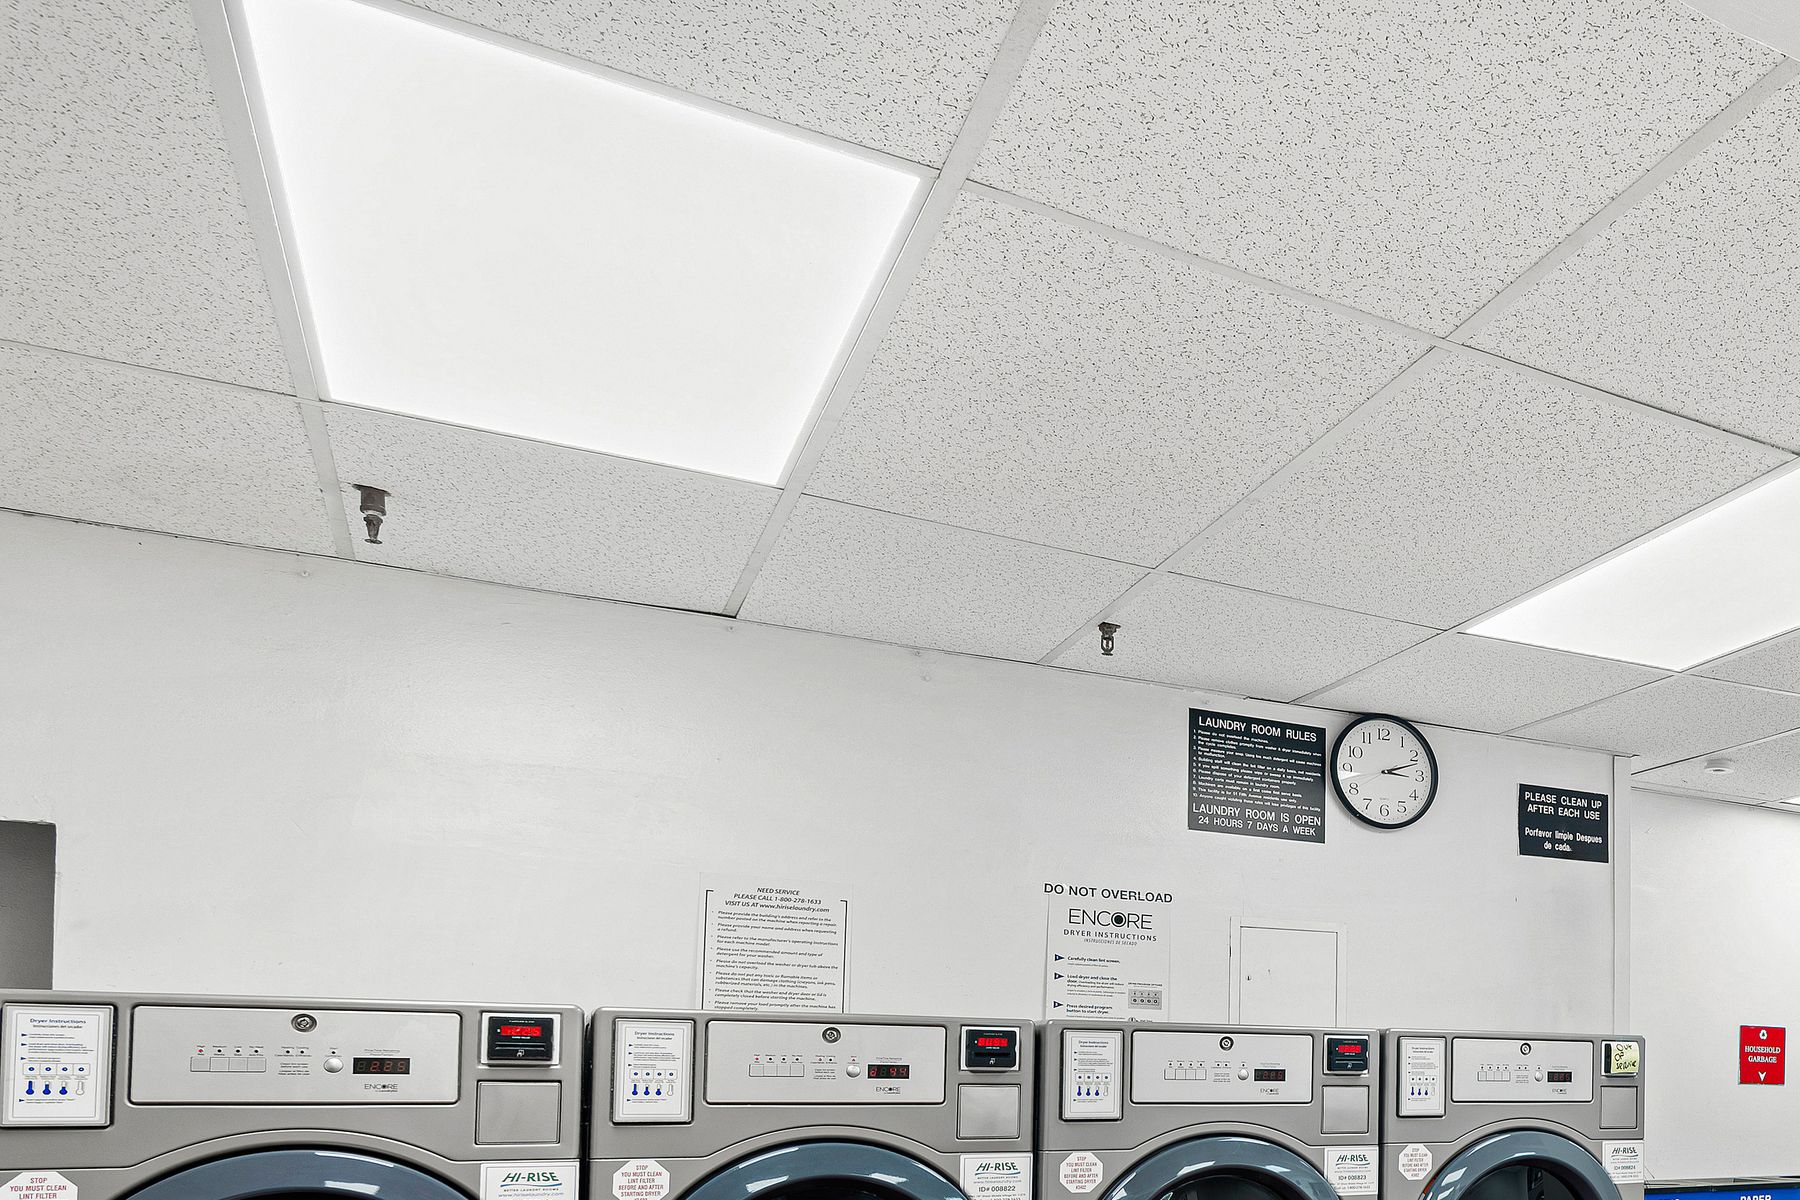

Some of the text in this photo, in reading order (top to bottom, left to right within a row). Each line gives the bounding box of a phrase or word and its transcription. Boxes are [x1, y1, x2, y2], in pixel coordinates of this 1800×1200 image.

[1198, 716, 1317, 742] LAUNDRY ROOM RULES
[1377, 728, 1390, 741] 12
[1362, 731, 1372, 744] 11
[1401, 736, 1404, 748] 1
[1348, 745, 1363, 758] 10
[1409, 750, 1419, 762] 2
[1342, 762, 1353, 773] 9
[1415, 770, 1424, 782] 3
[1348, 782, 1359, 795] 8
[1409, 789, 1419, 801] 4
[1363, 798, 1372, 810] 7
[1397, 800, 1407, 813] 5
[1525, 791, 1602, 809] PLEASE CLEAN UP
[1192, 803, 1321, 826] LAUNDRY ROOM IS OPEN
[1380, 804, 1389, 817] 6
[1527, 804, 1600, 820] AFTER EACH USE
[1198, 816, 1316, 836] 24 HOURS 7 DAYS A WEEK
[1576, 833, 1602, 843] Despues
[1543, 841, 1552, 850] de
[1044, 883, 1173, 903] DO NOT OVERLOAD
[1068, 908, 1153, 930] ENCORE
[1064, 929, 1092, 937] DRYER
[1094, 931, 1157, 942] INSTRUCTIONS
[1748, 1055, 1777, 1063] GARBAGE
[1337, 1154, 1368, 1162] HI-RISE
[976, 1162, 1018, 1171] HI-RISE
[502, 1172, 559, 1182] HI-RISE
